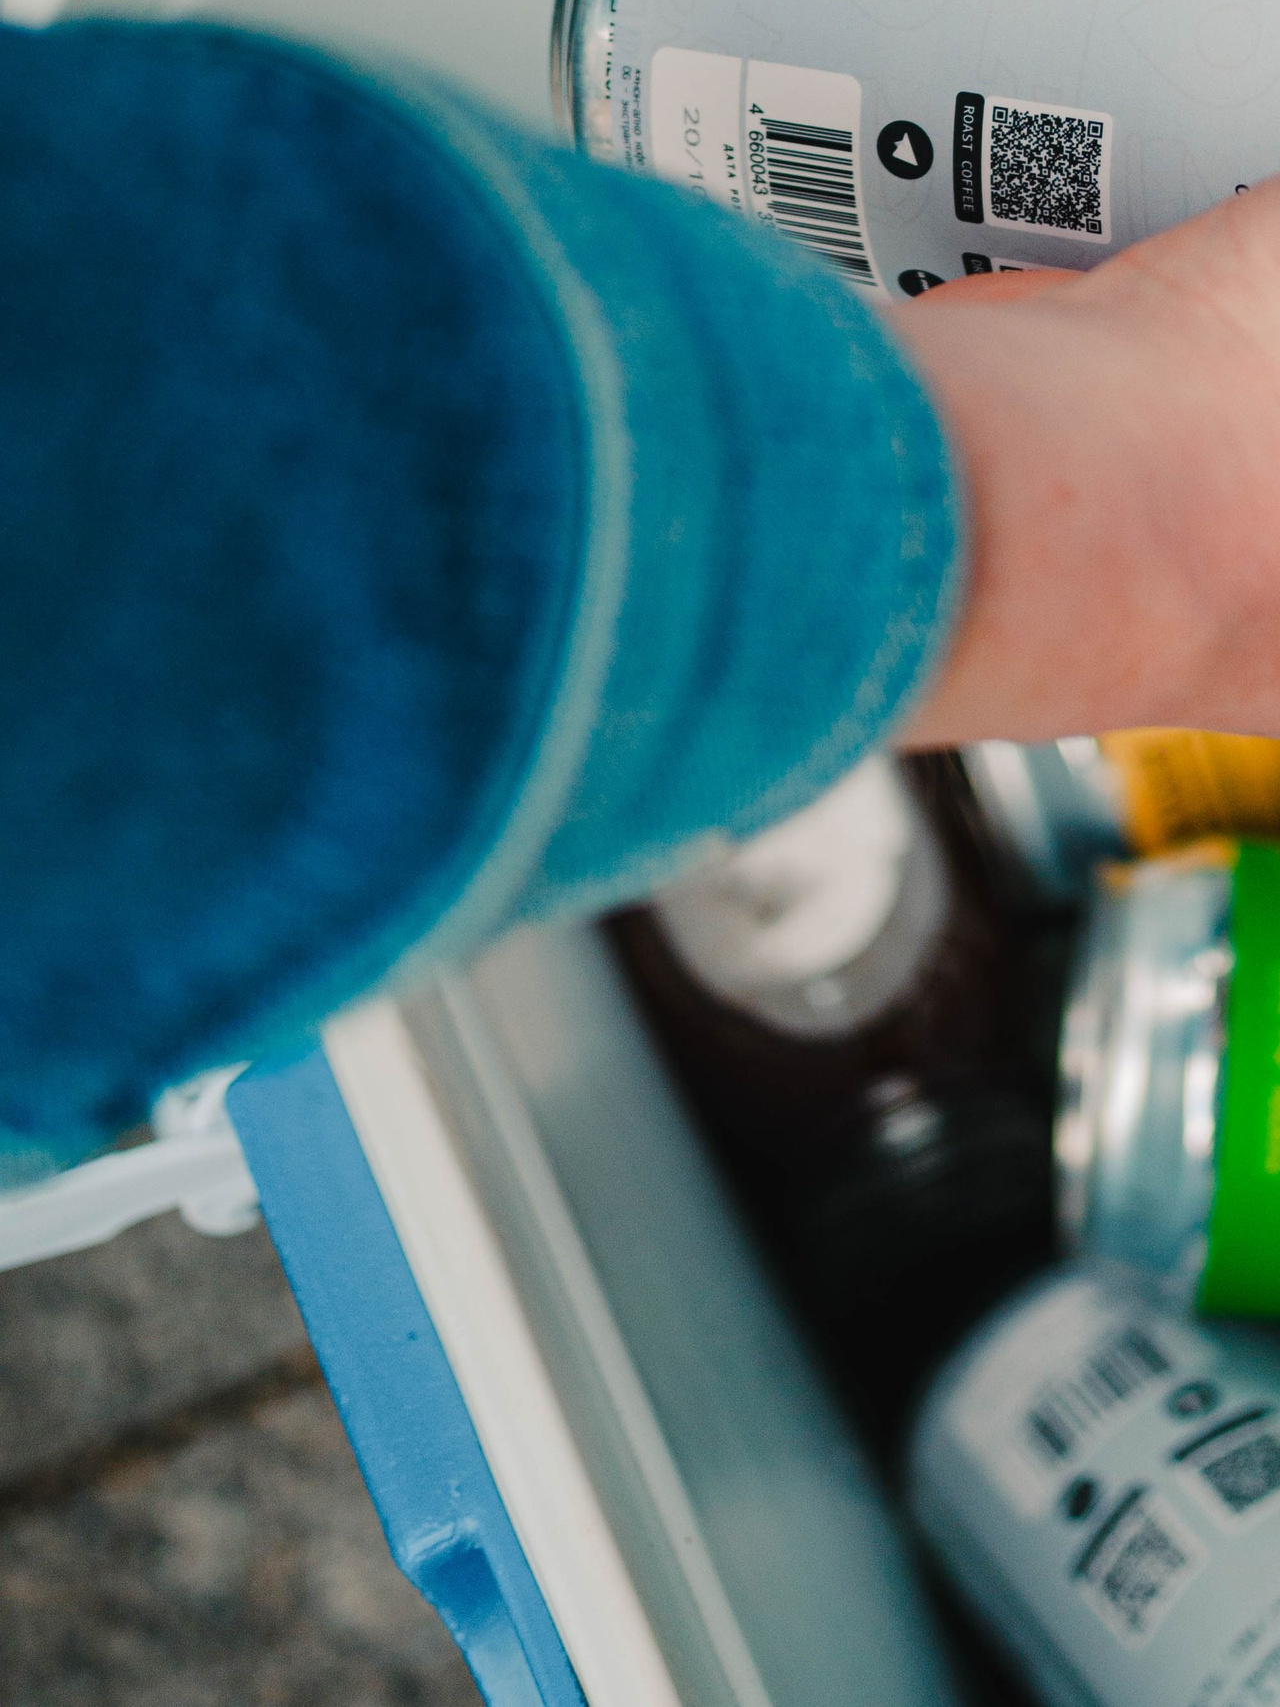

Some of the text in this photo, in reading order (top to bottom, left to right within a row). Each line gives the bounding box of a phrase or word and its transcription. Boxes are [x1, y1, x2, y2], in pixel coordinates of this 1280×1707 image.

[748, 102, 765, 115] 4
[722, 143, 737, 179] ДАТА
[748, 130, 768, 196] 660043
[960, 104, 976, 213] ROAST COFFEE
